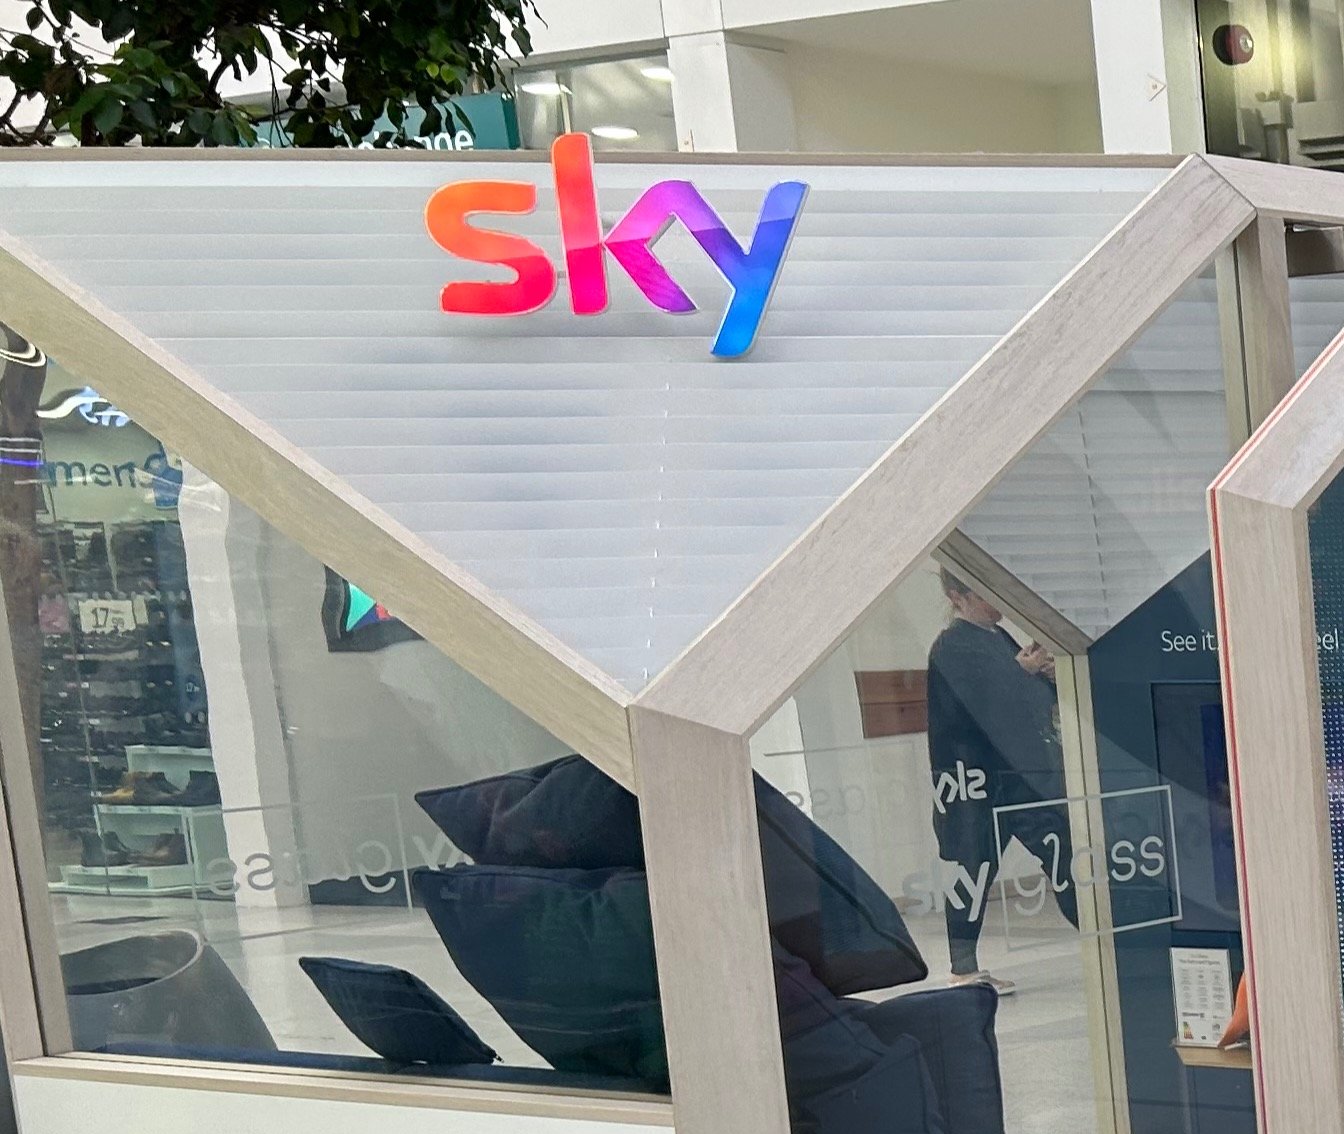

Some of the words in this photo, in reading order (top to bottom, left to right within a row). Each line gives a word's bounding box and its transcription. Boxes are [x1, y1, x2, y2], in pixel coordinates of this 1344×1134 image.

[424, 132, 810, 358] sky
[1161, 630, 1197, 652] See
[1315, 628, 1339, 651] eel
[901, 856, 990, 924] sky
[1012, 832, 1167, 918] glass
